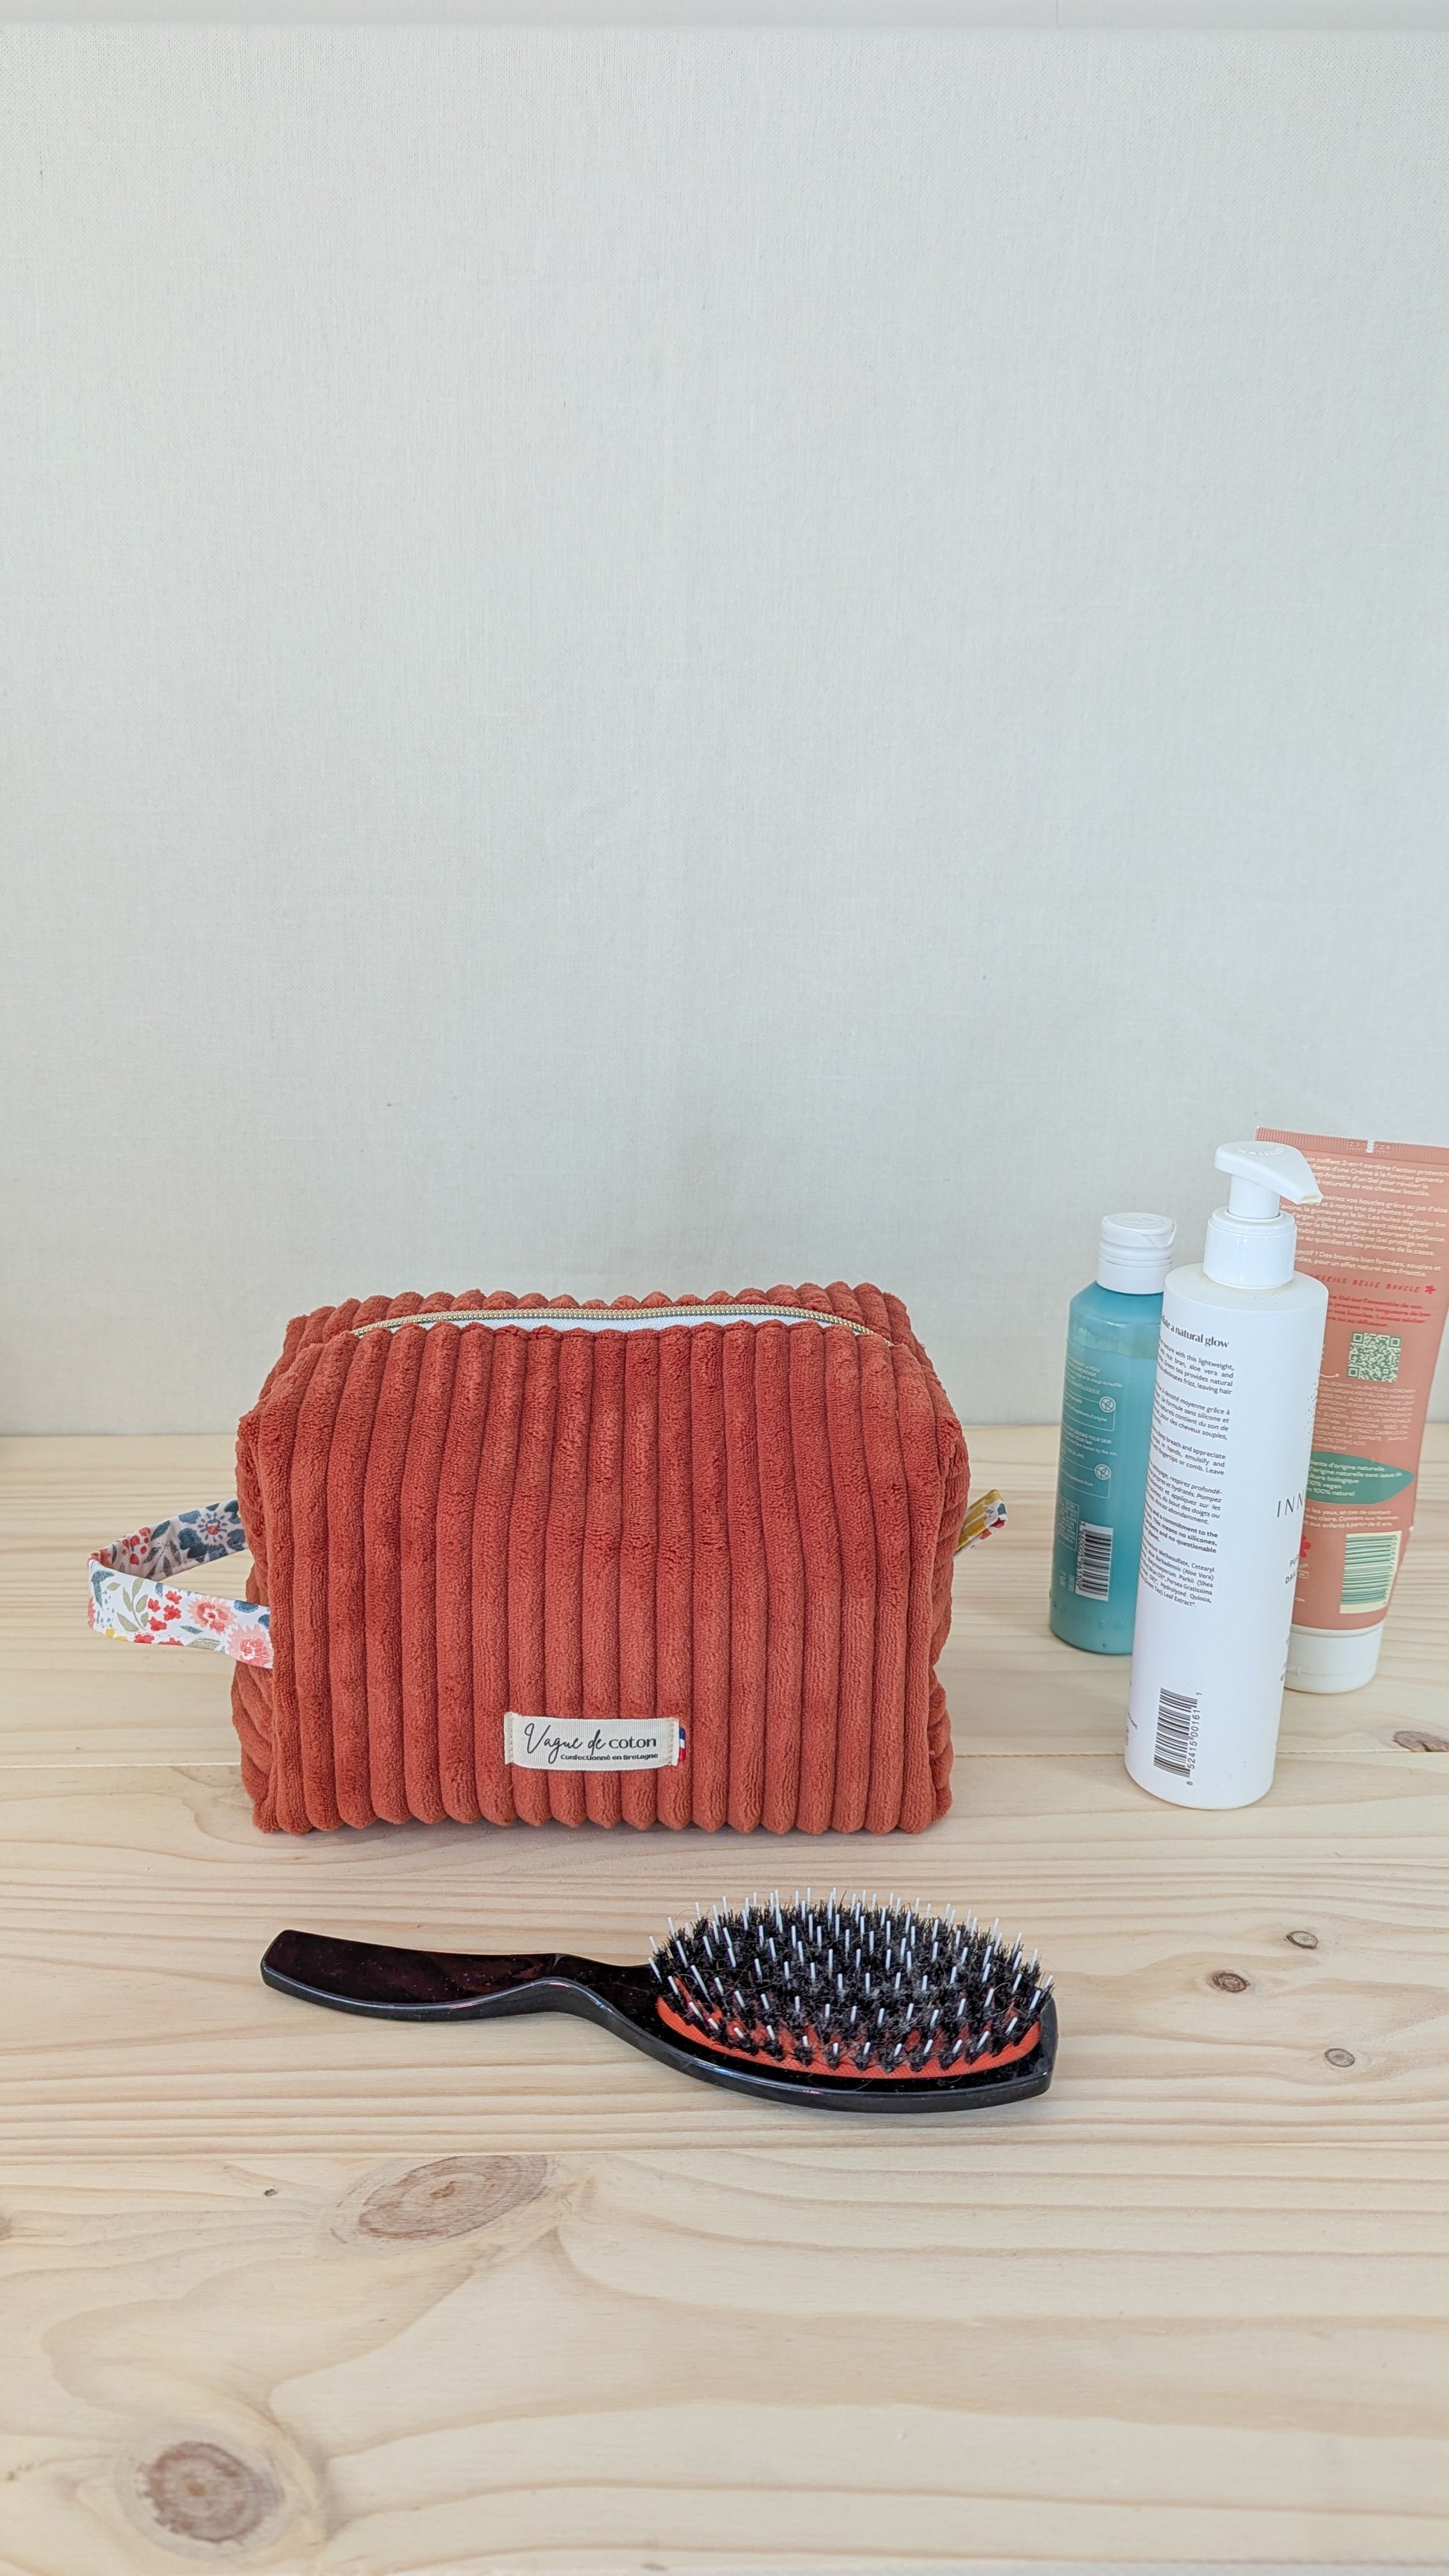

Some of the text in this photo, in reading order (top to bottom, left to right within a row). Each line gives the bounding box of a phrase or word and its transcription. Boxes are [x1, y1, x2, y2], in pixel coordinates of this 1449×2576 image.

[1386, 1172, 1414, 1180] fonction
[1359, 1198, 1385, 1206] boucles
[1321, 1221, 1337, 1230] fibre
[1376, 1229, 1407, 1238] favoriser
[1352, 1233, 1375, 1242] Crème
[1389, 1239, 1415, 1247] protège
[1364, 1243, 1395, 1251] préserve
[1334, 1253, 1359, 1262] boucles
[1375, 1258, 1405, 1268] formées,
[1352, 1279, 1421, 1293] BELLE BOUCLE
[1175, 1326, 1203, 1343] natural
[1205, 1336, 1229, 1348] glow
[1174, 1358, 1186, 1368] bran,
[1176, 1350, 1185, 1358] with
[1199, 1358, 1235, 1371] lightweight,
[1183, 1378, 1196, 1388] frizz,
[1197, 1382, 1218, 1394] leaving
[1184, 1371, 1208, 1382] provides
[1210, 1378, 1233, 1387] natural
[1164, 1390, 1179, 1402] densité
[1179, 1399, 1206, 1411] moyenne
[1166, 1399, 1183, 1411] formule
[1197, 1413, 1220, 1423] silicone
[1175, 1413, 1197, 1425] contient
[1179, 1422, 1200, 1434] cheveux
[1202, 1431, 1227, 1440] souples,
[1166, 1437, 1226, 1460] breath and appreciate
[1167, 1445, 1182, 1457] hands,
[1185, 1454, 1210, 1466] emulsify
[1186, 1462, 1204, 1472] comb.
[1328, 1462, 1356, 1471] d'origine
[1170, 1476, 1222, 1495] respirez profondé-
[1327, 1475, 1359, 1484] biologique
[1171, 1485, 1195, 1497] hydratés.
[1197, 1493, 1222, 1503] Pompez
[1171, 1493, 1197, 1505] appliquez
[1168, 1498, 1179, 1508] bout
[1191, 1508, 1210, 1517] doigts
[1168, 1507, 1209, 1524] abondamment.
[1163, 1516, 1197, 1533] commitment
[1159, 1530, 1168, 1539] and
[1176, 1539, 1217, 1553] questionable
[1162, 1523, 1177, 1534] means
[1188, 1535, 1217, 1546] silicones,
[1156, 1555, 1214, 1581] Barbadensis (Aloe Vera)
[1159, 1550, 1214, 1574] Methosulfate, Cetearyl
[1167, 1577, 1212, 1595] Persea Gratissima
[1179, 1574, 1213, 1588] Parkii (Shea
[1161, 1582, 1211, 1603] Hydrolyzed Quinoa,
[1191, 1710, 1201, 1737] 00161
[524, 1723, 657, 1764] Vague de coton
[1187, 1740, 1197, 1769] 52415
